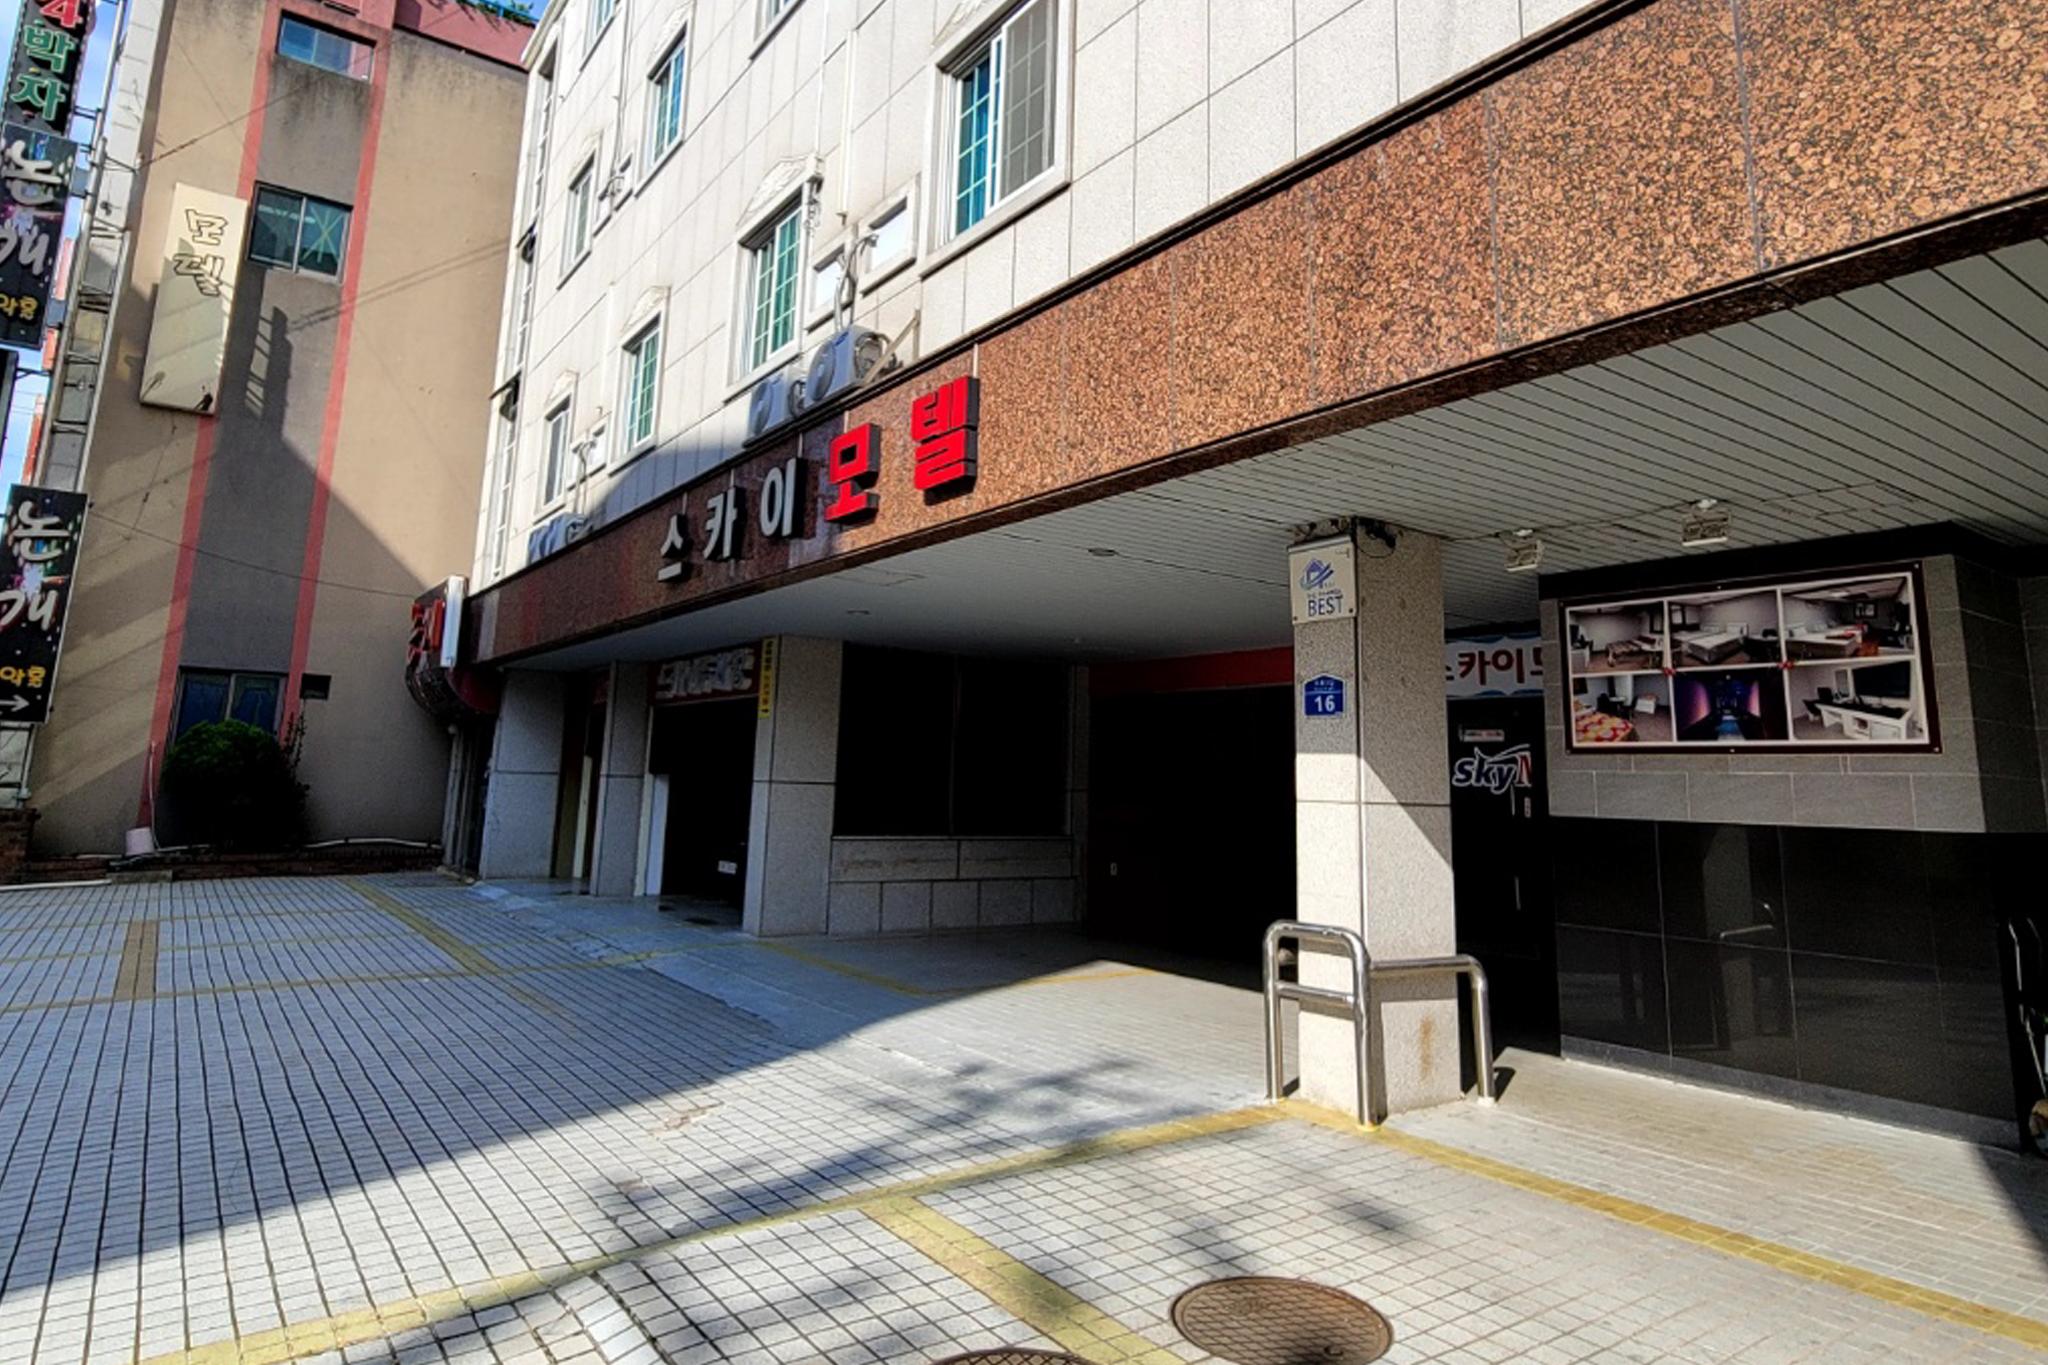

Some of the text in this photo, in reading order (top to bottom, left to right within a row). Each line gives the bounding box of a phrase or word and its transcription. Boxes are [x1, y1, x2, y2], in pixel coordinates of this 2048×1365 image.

[173, 208, 229, 296] 모텔
[1307, 594, 1344, 617] BEST
[1313, 694, 1336, 713] 16
